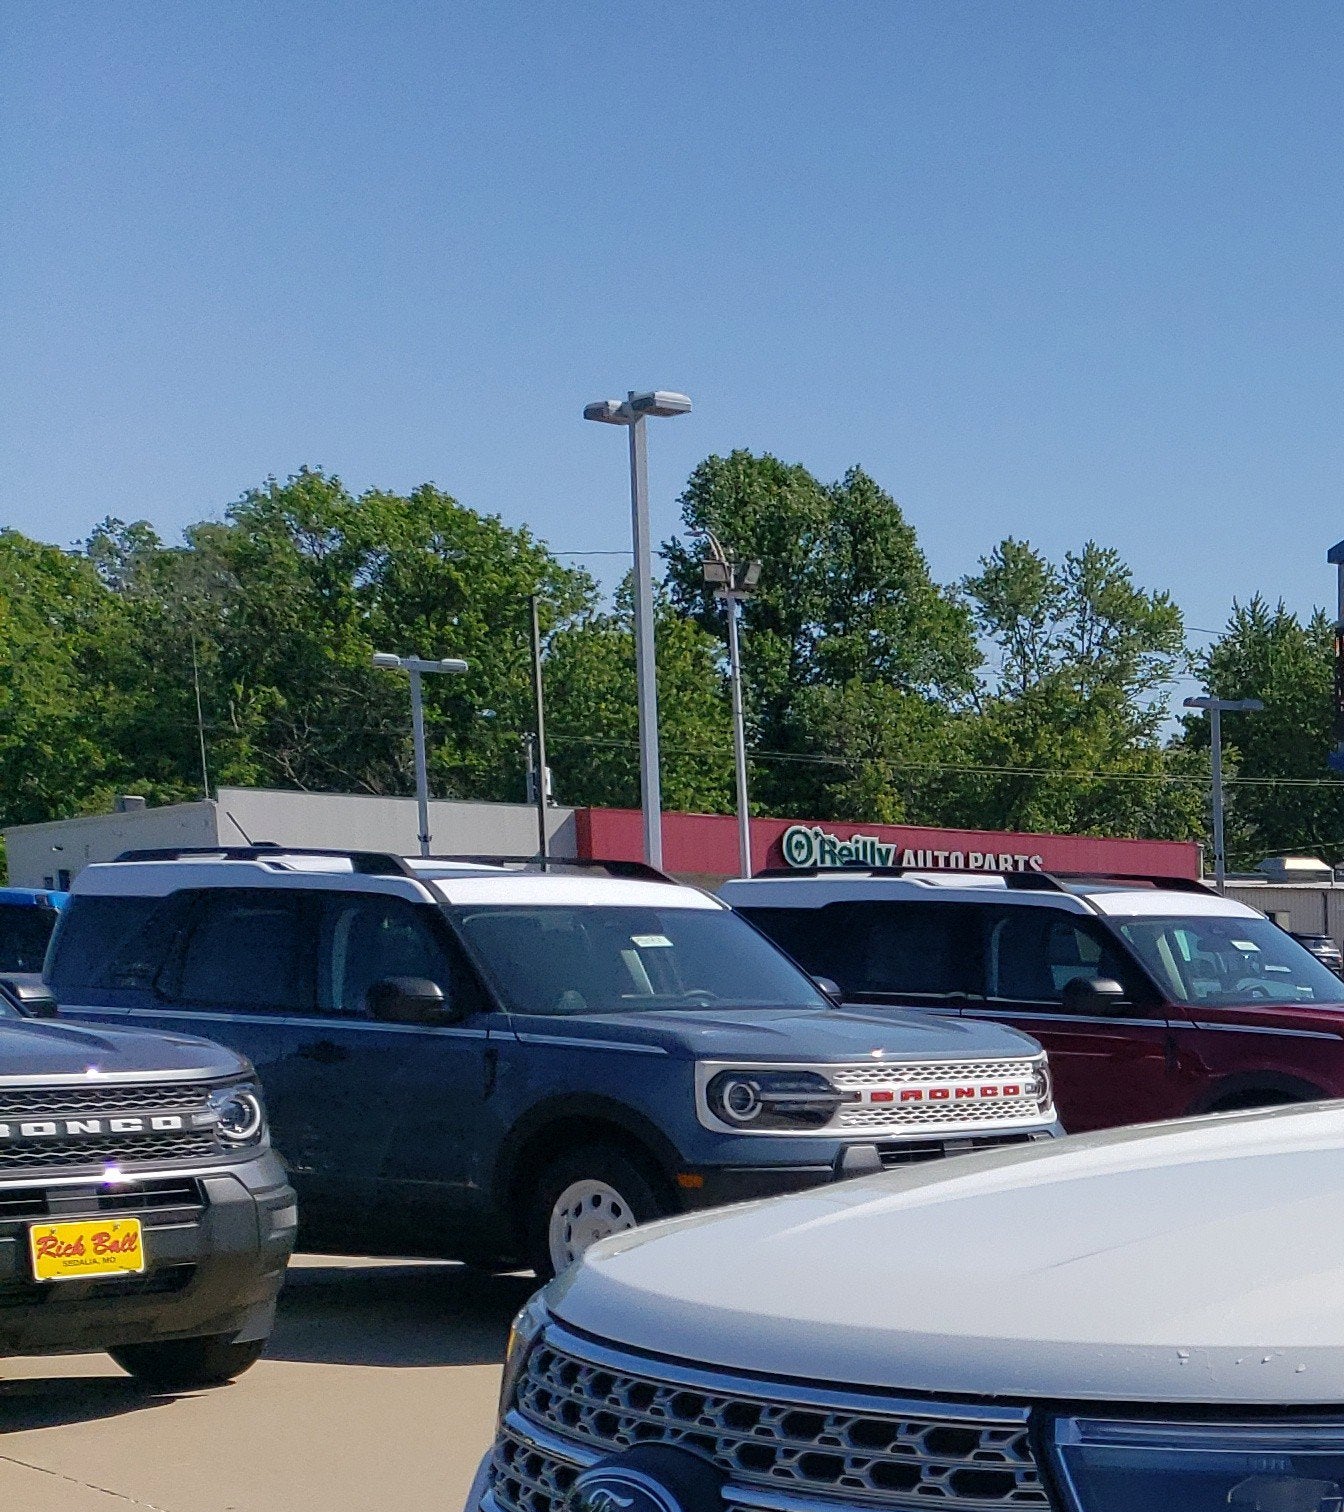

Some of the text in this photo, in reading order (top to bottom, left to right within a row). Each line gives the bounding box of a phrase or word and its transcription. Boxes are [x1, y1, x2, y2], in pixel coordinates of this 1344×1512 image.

[783, 825, 1043, 872] O'Reilly AUTO PARTS
[871, 1085, 1020, 1102] BRONCO
[36, 1232, 138, 1260] Rich Ball
[102, 1256, 117, 1264] MO
